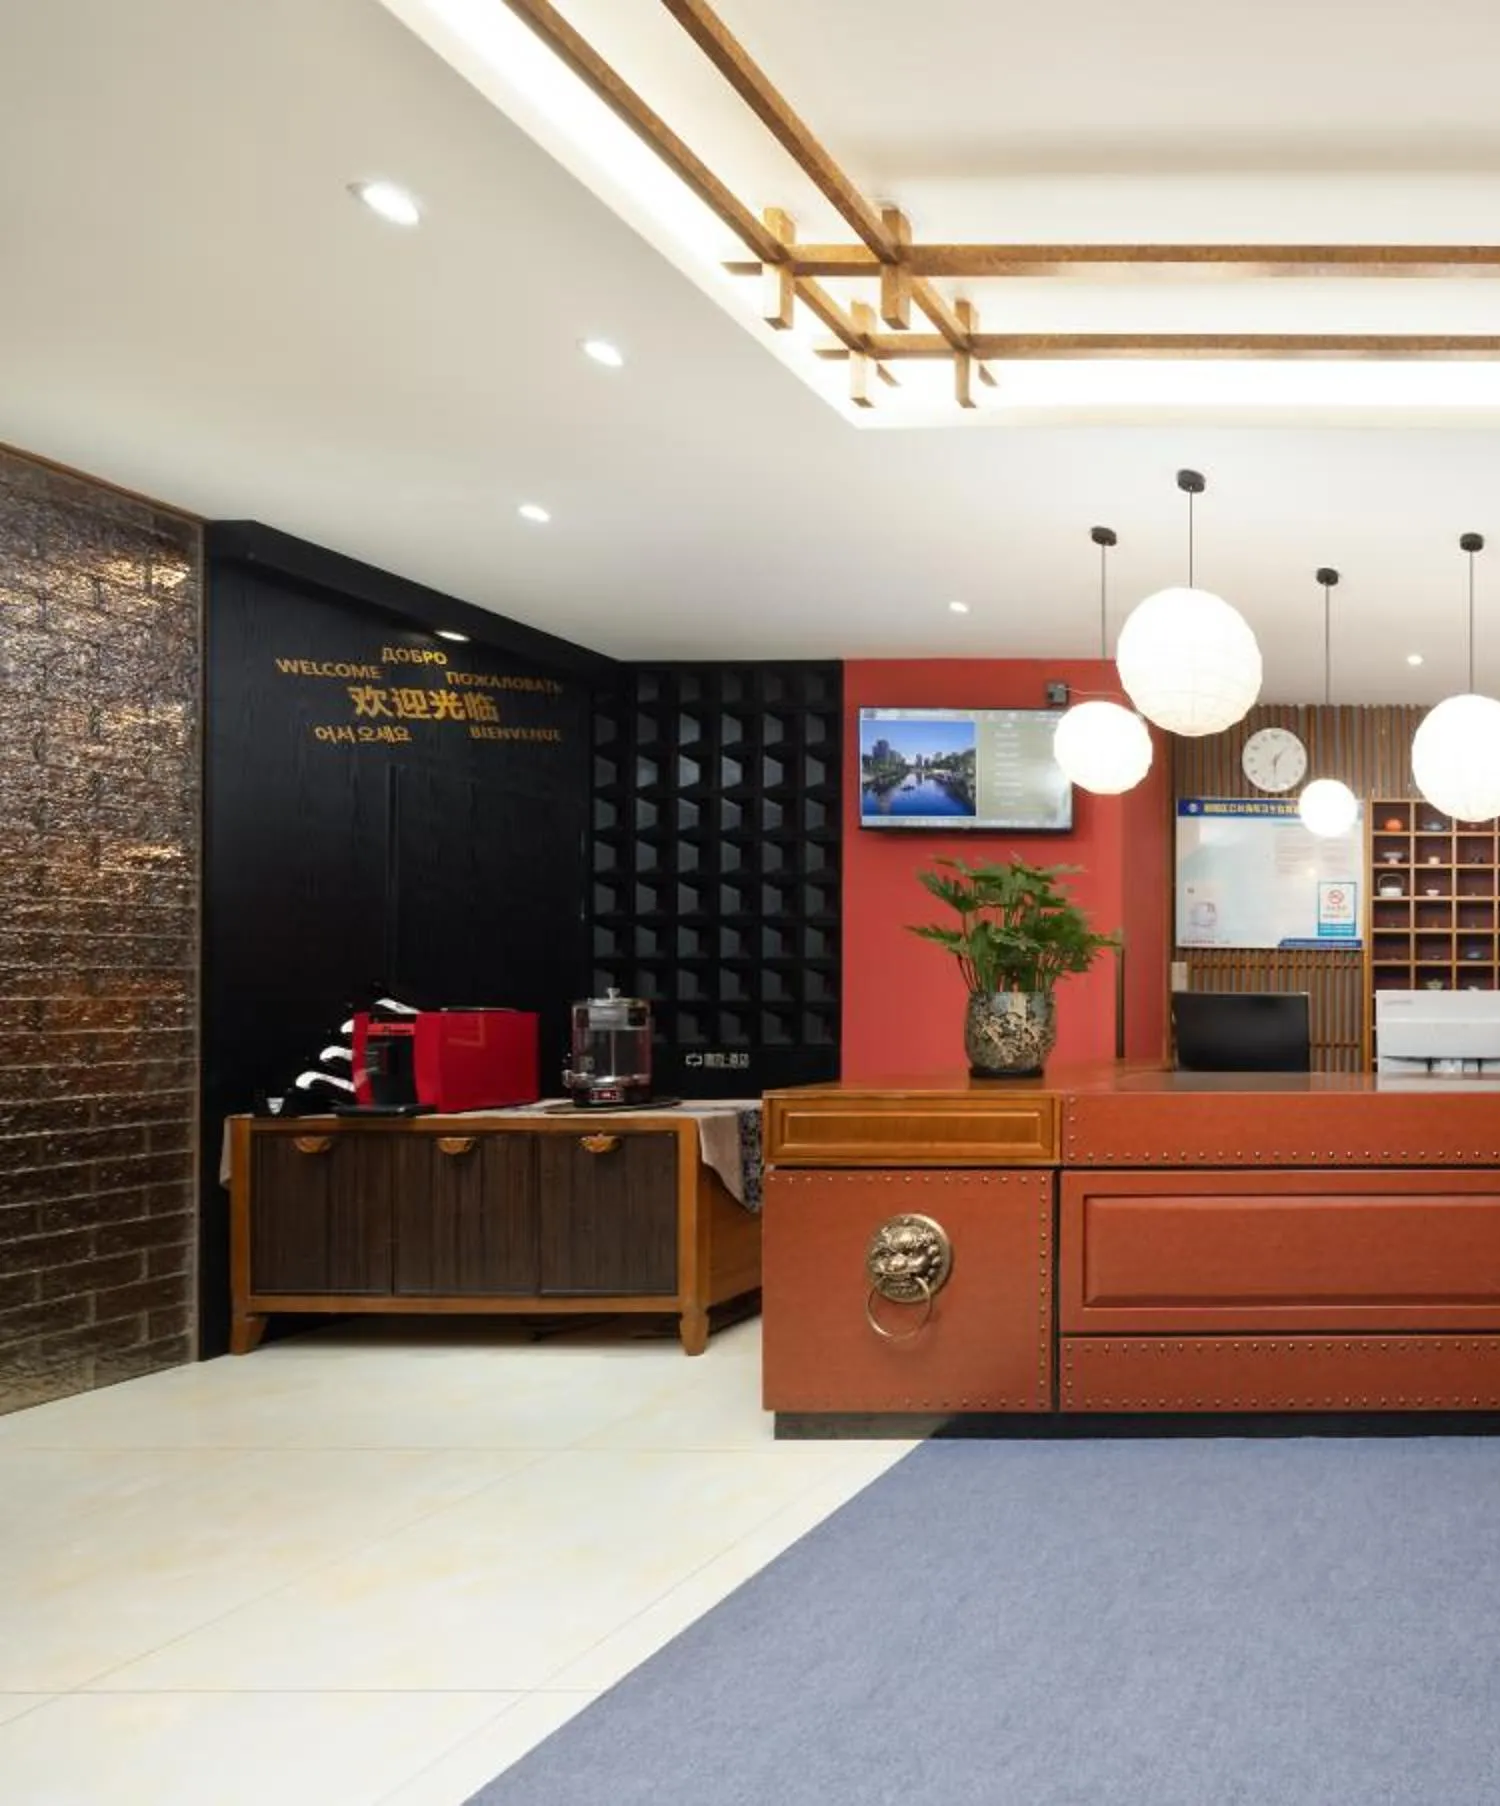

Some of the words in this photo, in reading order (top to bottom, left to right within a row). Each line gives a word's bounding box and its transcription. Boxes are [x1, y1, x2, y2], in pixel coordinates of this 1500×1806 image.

[381, 647, 447, 665] ДОБРО
[275, 658, 383, 680] WELCOME
[347, 685, 499, 722] 欢迎光临
